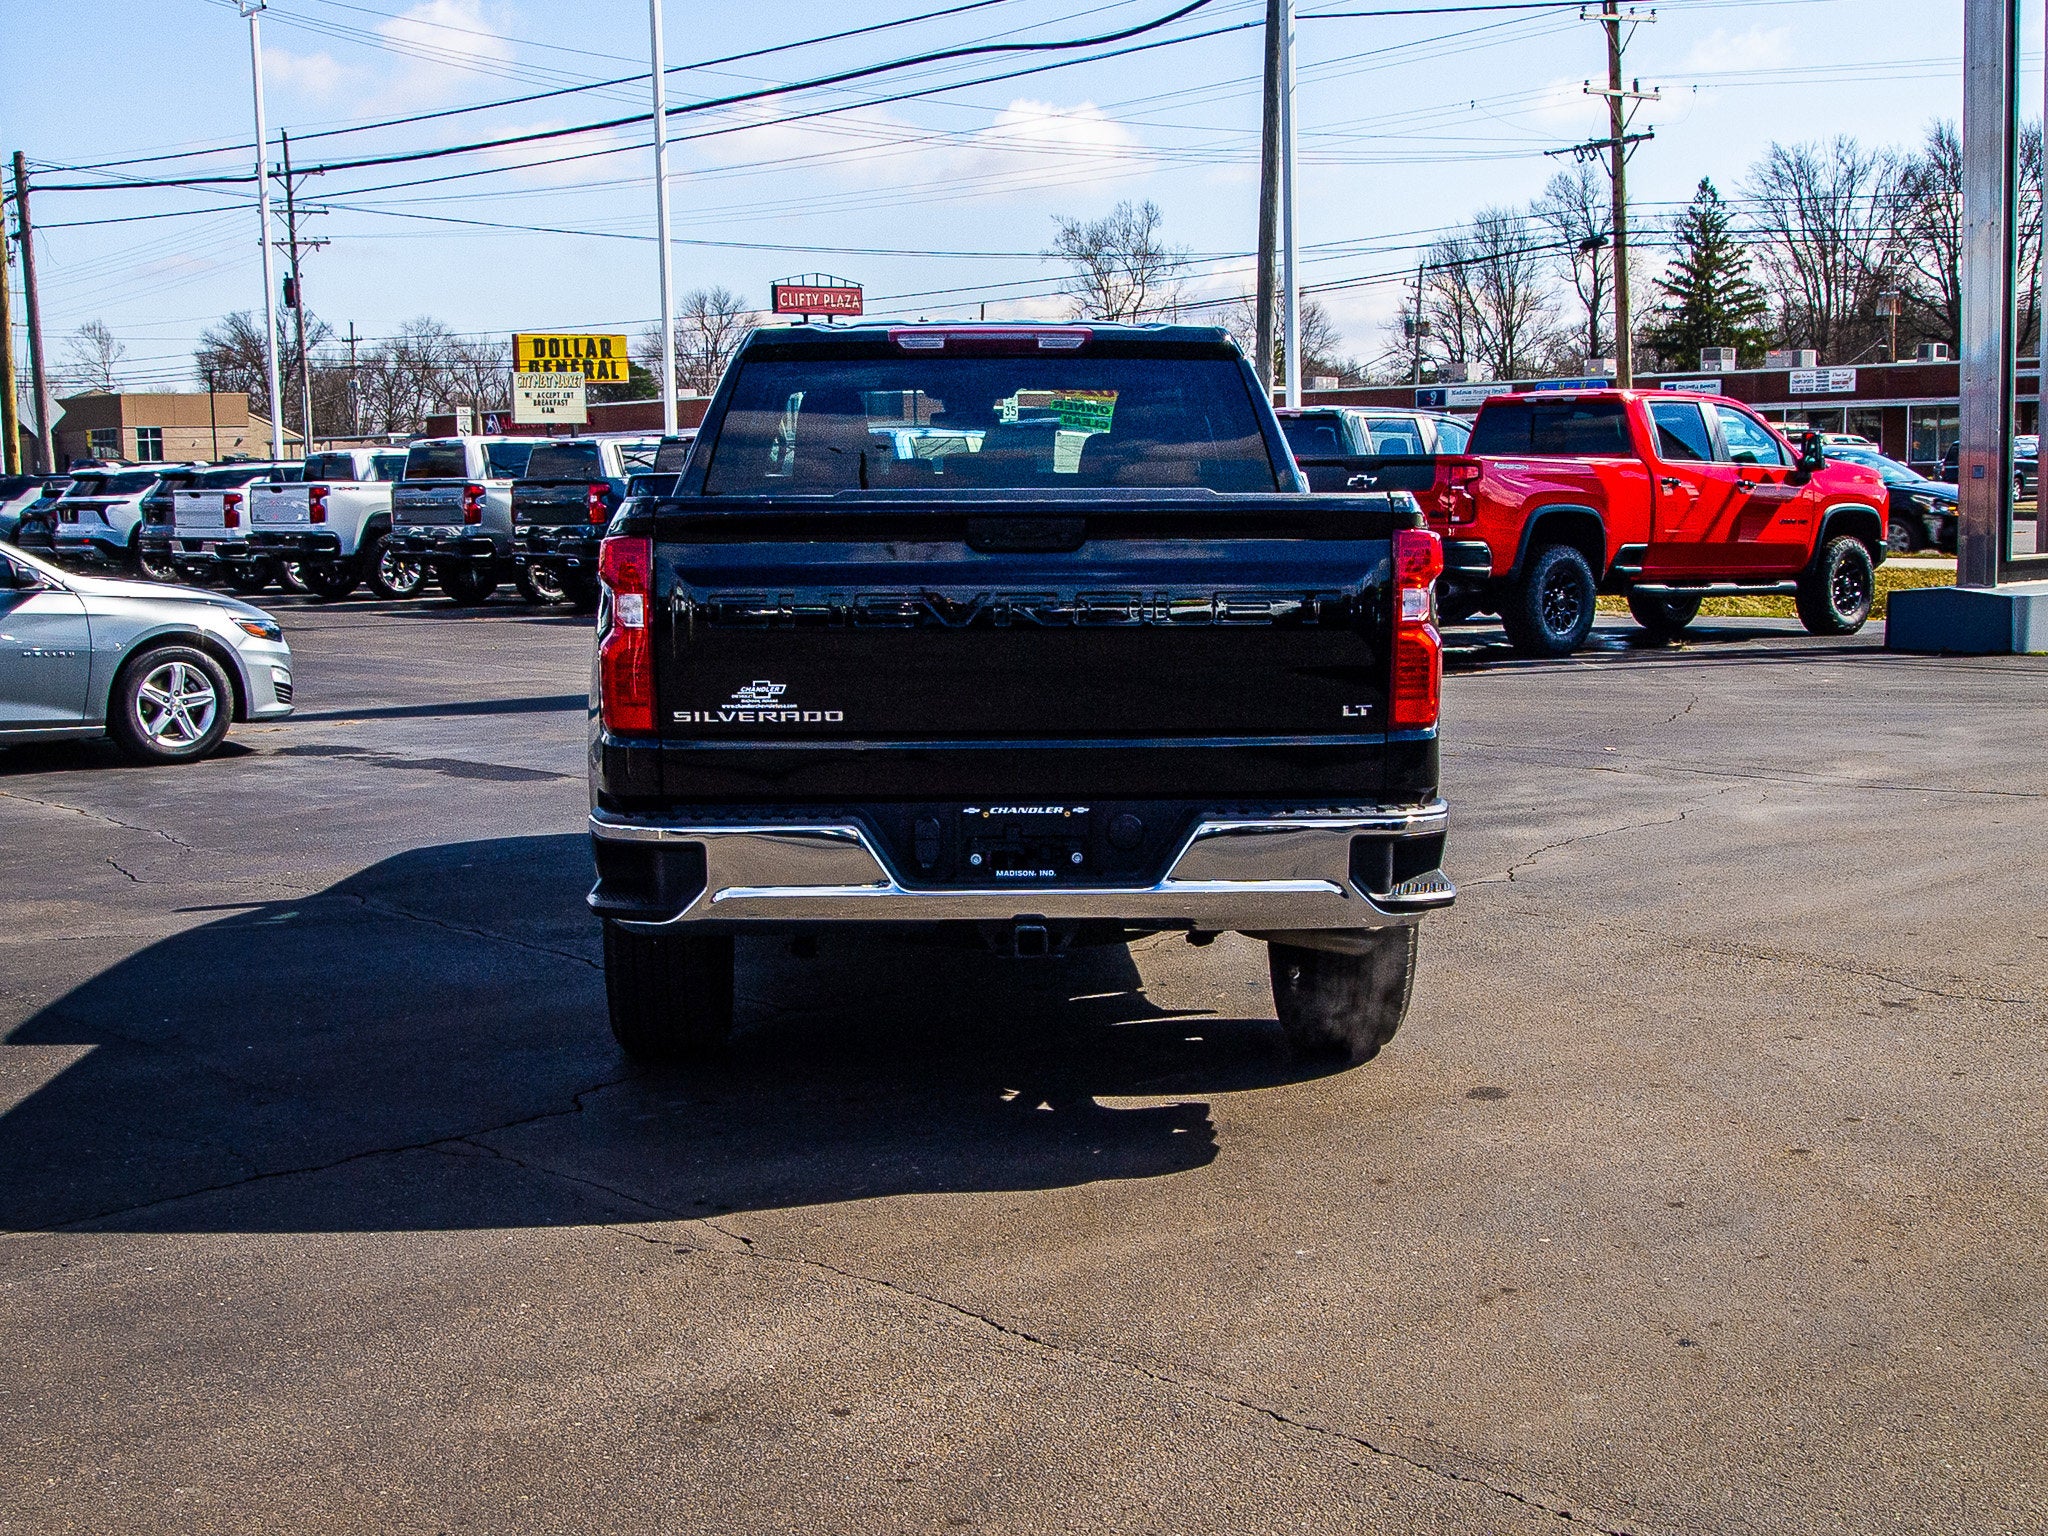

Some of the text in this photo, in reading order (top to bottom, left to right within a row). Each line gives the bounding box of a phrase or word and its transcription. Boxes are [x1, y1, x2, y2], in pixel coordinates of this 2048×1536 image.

[780, 292, 860, 308] CLIFTY PLAZA
[533, 337, 612, 358] DOLLAR
[533, 399, 569, 407] BREAKFAST
[1005, 405, 1017, 417] 35
[706, 592, 1341, 628] CHEVROLET
[673, 710, 844, 723] SILVERADO
[1342, 704, 1373, 717] LT
[989, 806, 1064, 815] CHANDLER
